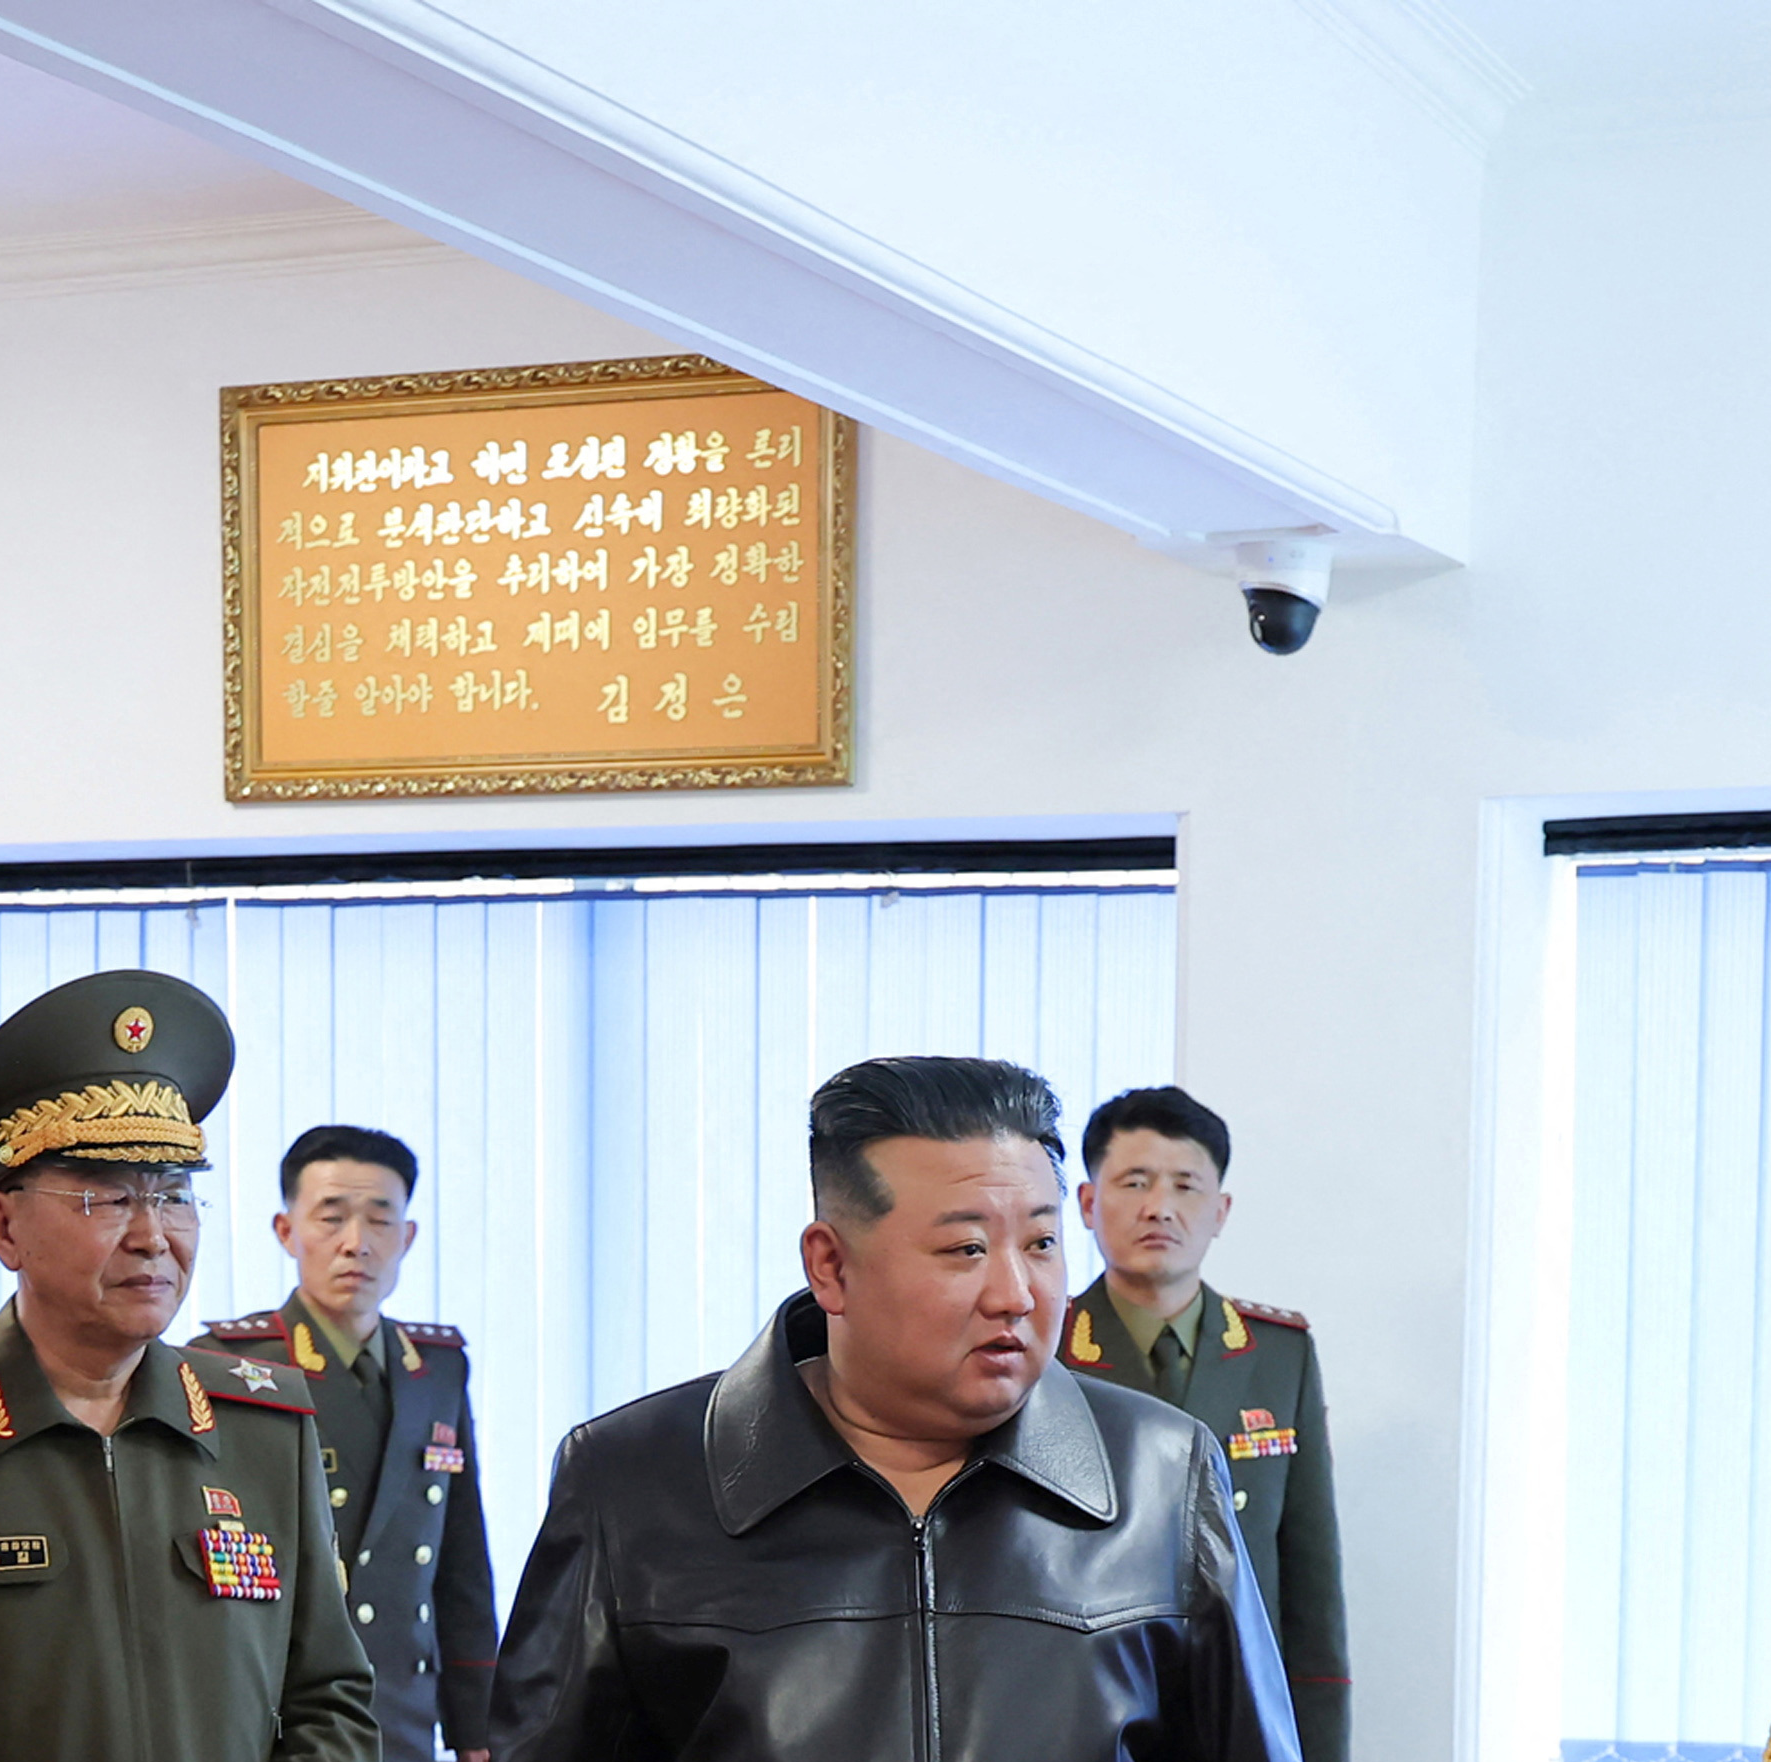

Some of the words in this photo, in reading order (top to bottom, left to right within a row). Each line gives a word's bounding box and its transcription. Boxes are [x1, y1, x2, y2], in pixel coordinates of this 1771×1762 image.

[746, 426, 800, 468] 론리
[277, 511, 360, 550] 적으로
[572, 489, 663, 538] 신속히
[684, 484, 799, 530] 최량화된
[278, 558, 478, 606] 작전전투방안을
[496, 548, 608, 596] 추리하여
[628, 545, 694, 589] 가장
[710, 541, 803, 585] 정확한
[281, 622, 364, 665] 결심을
[633, 607, 717, 649] 임무를
[283, 679, 338, 718] 할줄
[354, 672, 434, 716] 알아야
[449, 669, 539, 712] 합니다.
